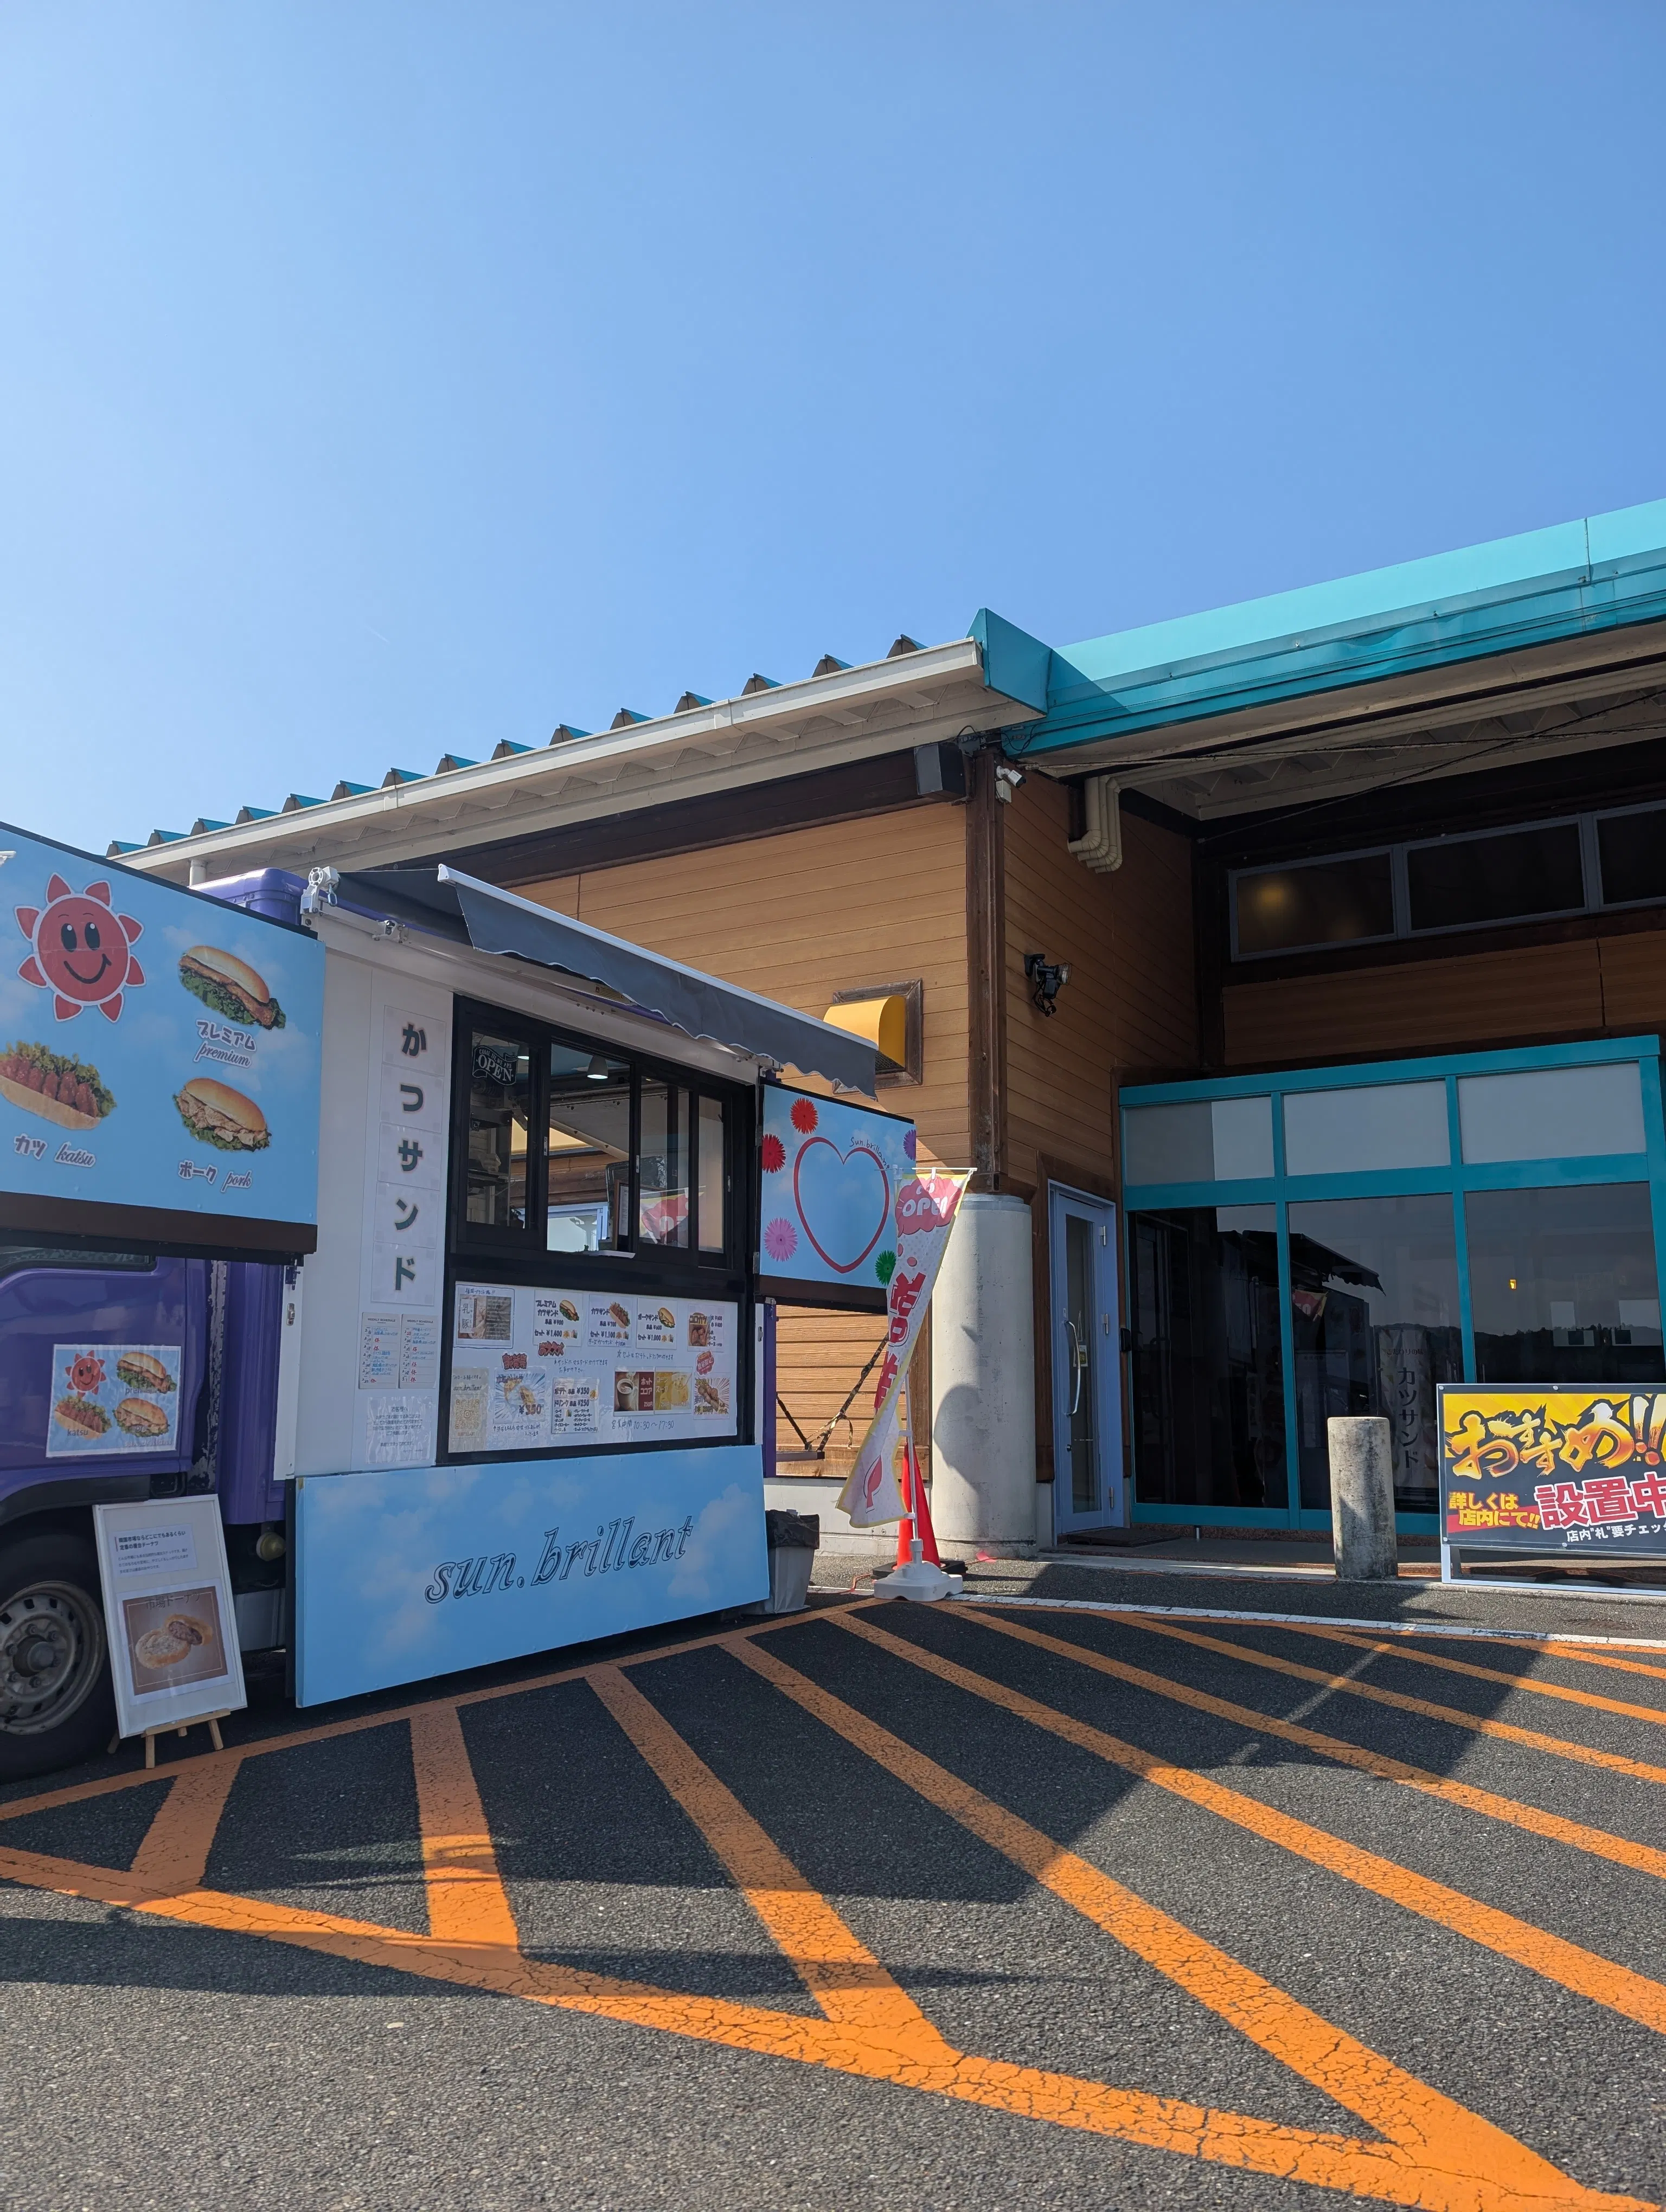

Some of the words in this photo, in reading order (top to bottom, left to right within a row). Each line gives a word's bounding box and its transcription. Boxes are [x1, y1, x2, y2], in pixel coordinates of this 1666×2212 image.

[197, 1021, 255, 1051] プレミアム
[195, 1042, 252, 1067] premium
[478, 1054, 512, 1081] OPEN
[15, 1135, 46, 1159] カツ
[56, 1142, 95, 1167] katsu
[395, 1023, 427, 1291] かつサンド
[180, 1161, 216, 1184] ポーク
[222, 1171, 252, 1192] pork
[902, 1196, 948, 1217] OPEN
[67, 1427, 88, 1436] katsu
[1398, 1367, 1419, 1468] カツサンド
[1448, 1492, 1519, 1510] 詳しくは
[1459, 1508, 1541, 1529] 店内にて!!
[425, 1516, 693, 1604] sun.brillant
